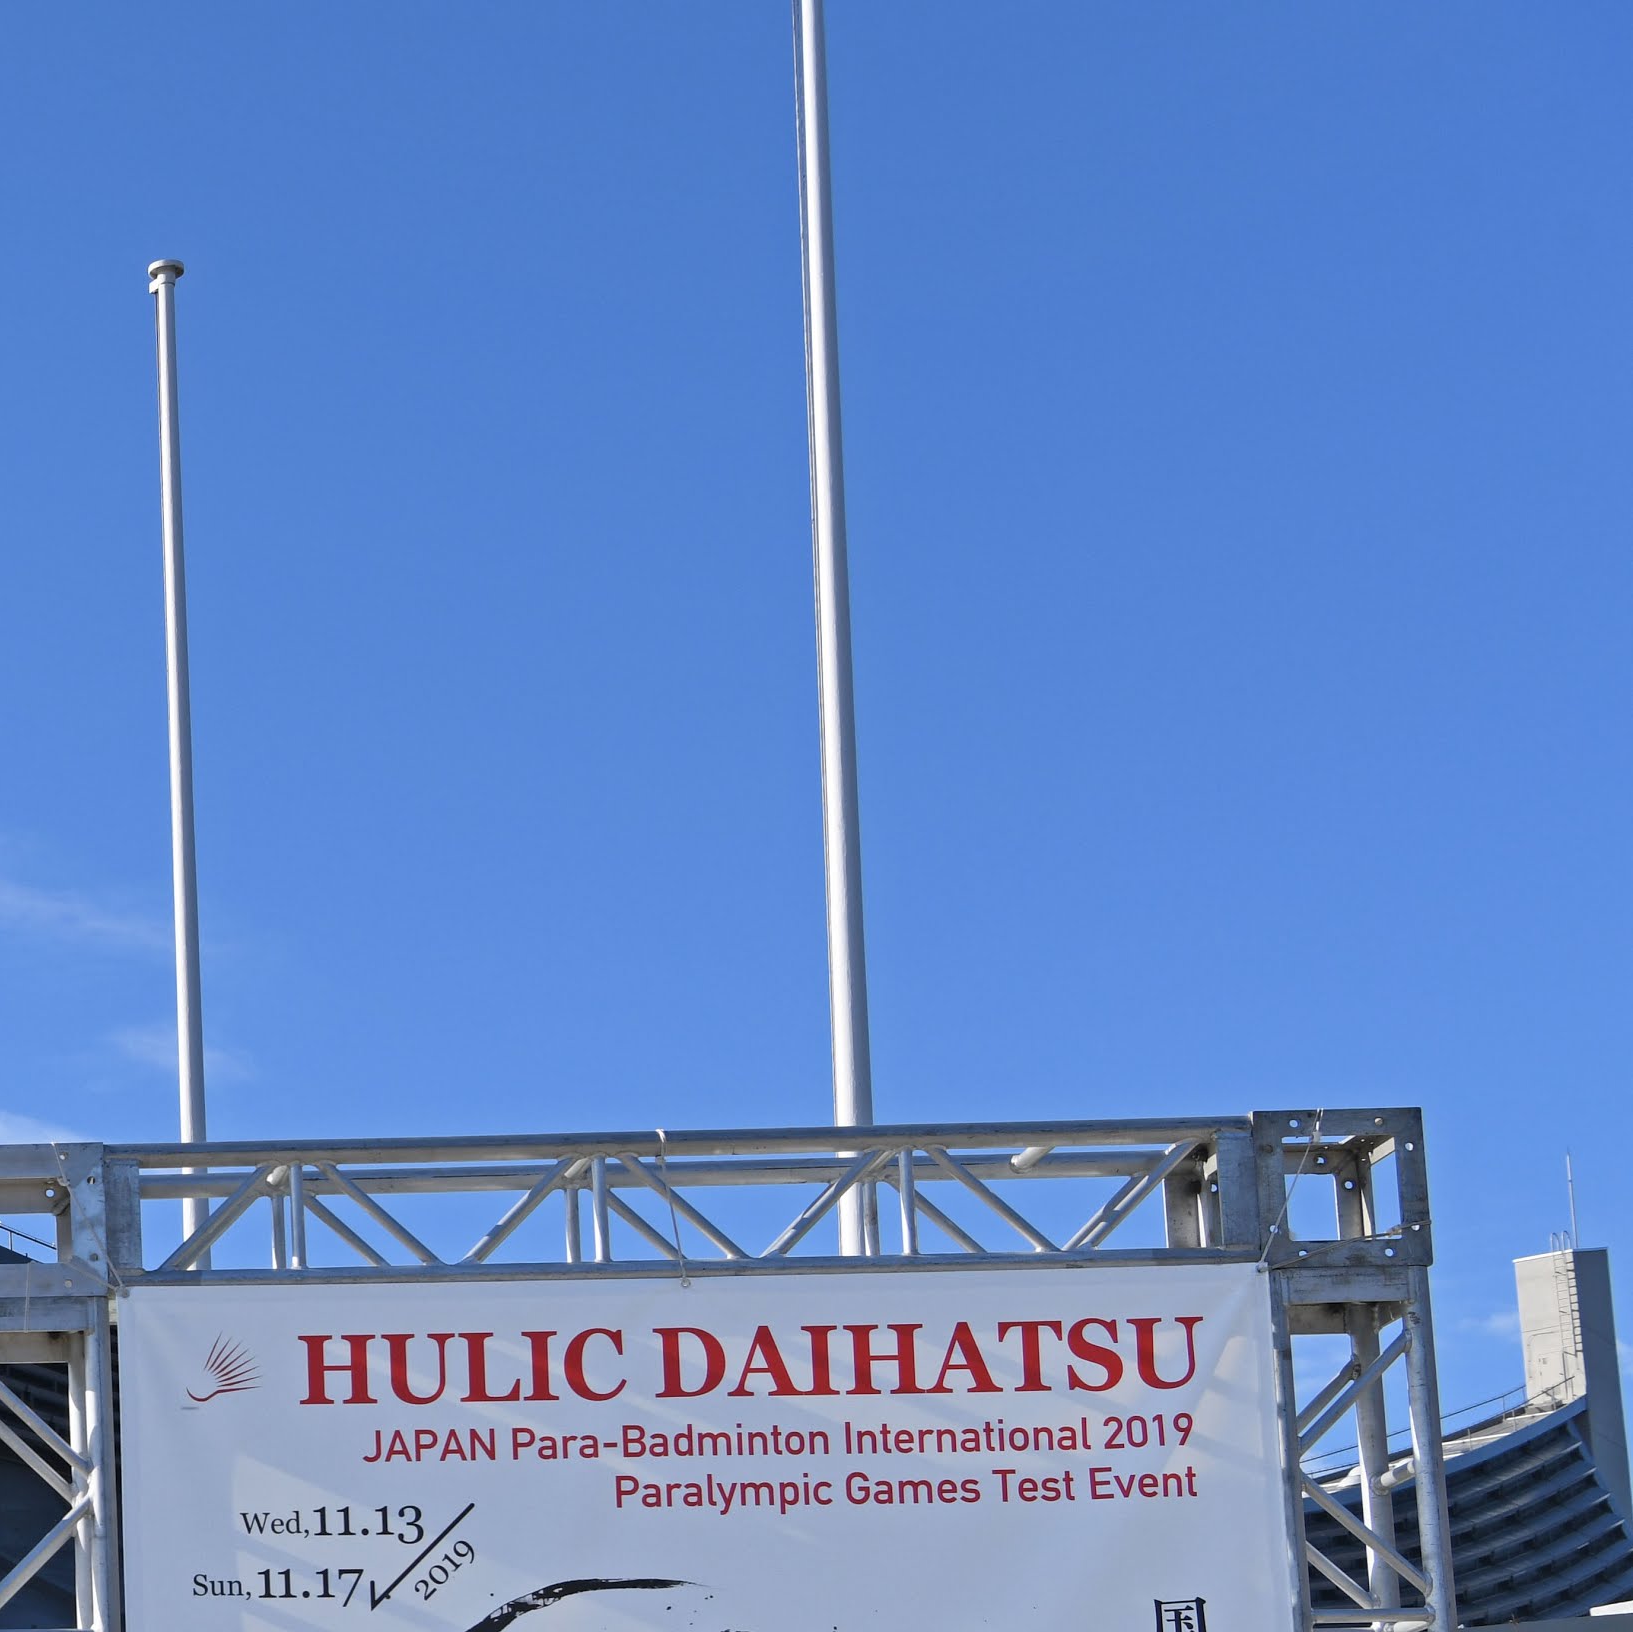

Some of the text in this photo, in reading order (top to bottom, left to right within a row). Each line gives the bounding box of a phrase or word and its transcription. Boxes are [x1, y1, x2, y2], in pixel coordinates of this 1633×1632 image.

[297, 1316, 1204, 1406] HULIC DAIHATSU
[362, 1412, 1194, 1463] JAPAN Para-Badminton International 2019
[615, 1466, 1198, 1516] Paralympic Games Test Event
[415, 1539, 478, 1602] 2019
